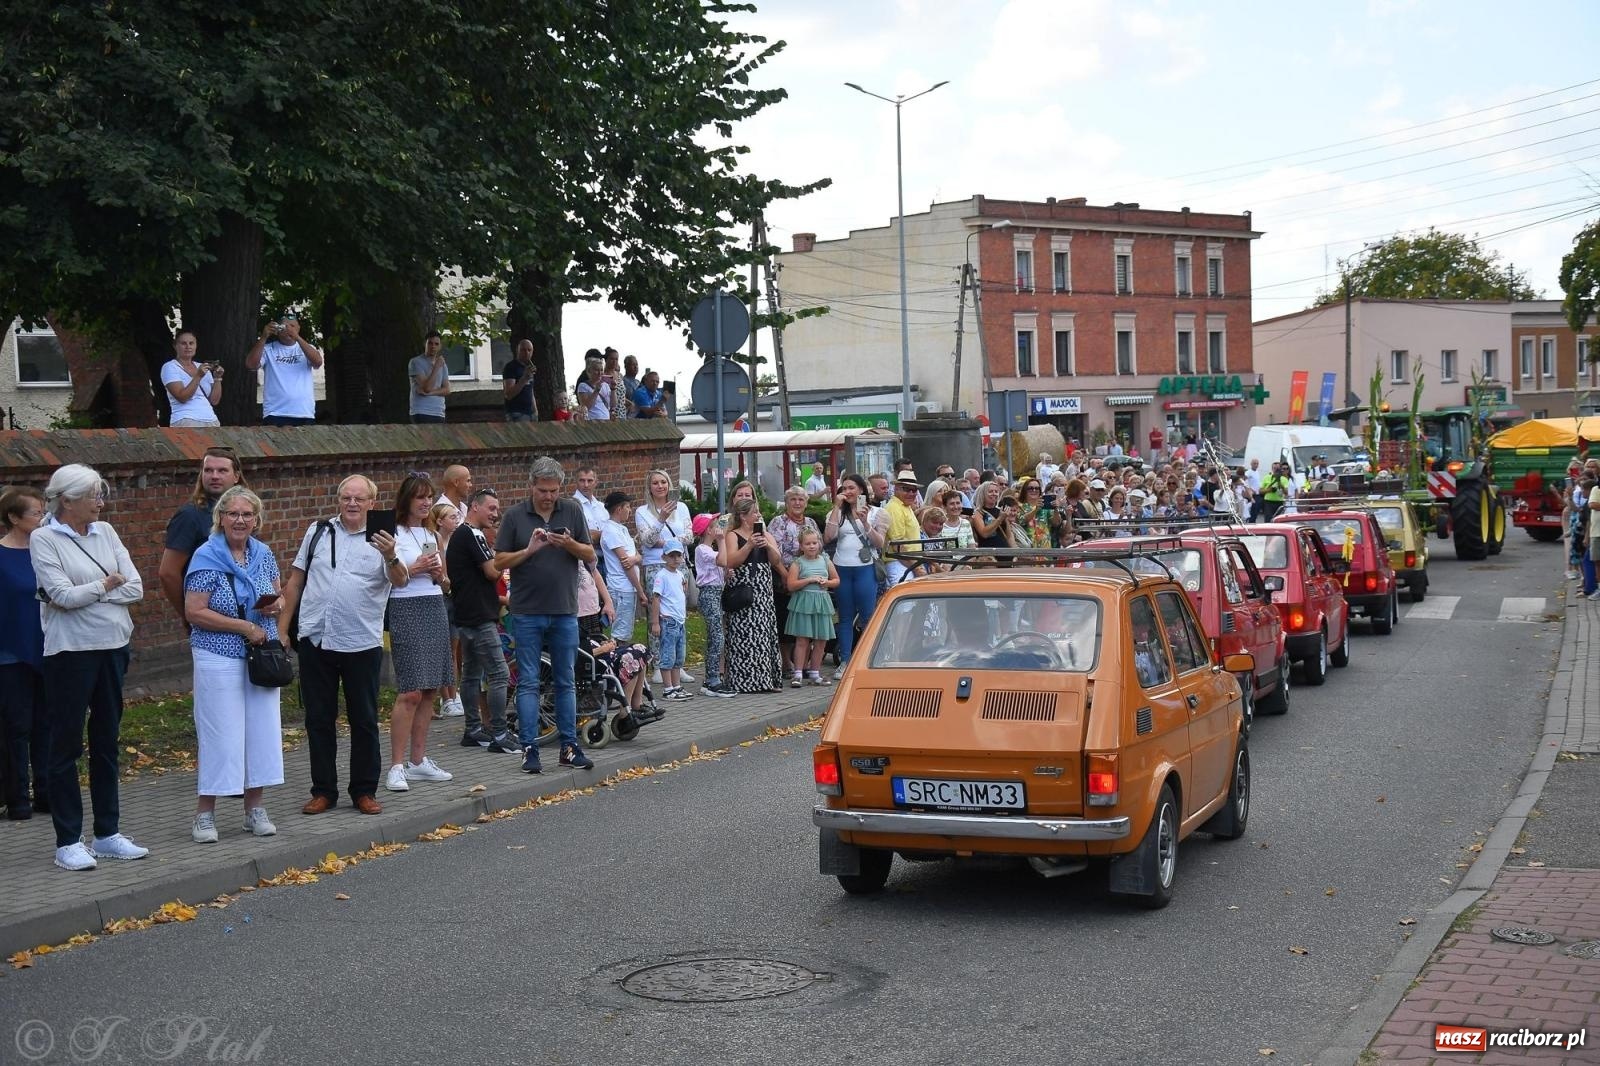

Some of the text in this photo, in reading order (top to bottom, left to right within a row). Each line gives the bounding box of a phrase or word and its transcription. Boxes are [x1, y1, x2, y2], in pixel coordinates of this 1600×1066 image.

[1159, 376, 1242, 395] APTEKA
[1050, 399, 1078, 408] MAXPOL
[851, 757, 887, 767] 650 E
[908, 781, 1018, 805] SRC NM33
